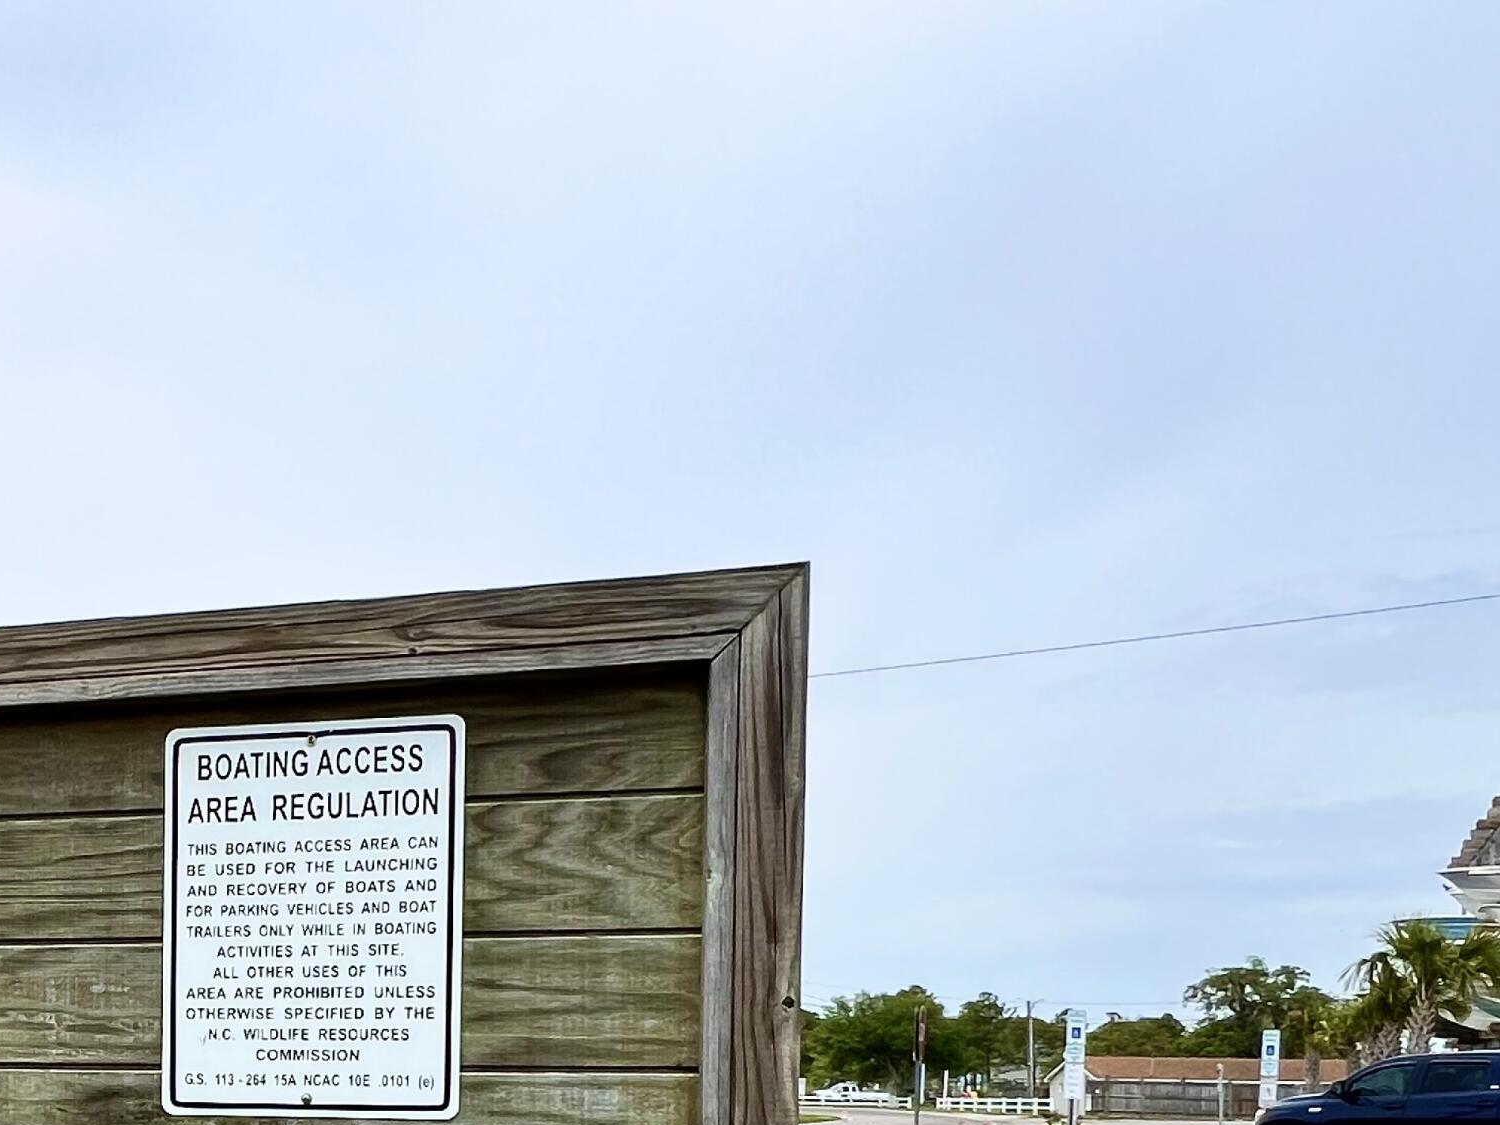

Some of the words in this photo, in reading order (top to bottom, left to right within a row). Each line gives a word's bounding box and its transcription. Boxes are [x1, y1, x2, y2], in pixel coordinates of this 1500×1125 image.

[198, 750, 308, 780] BOATING
[316, 744, 422, 776] ACCESS
[188, 796, 256, 823] AREA
[273, 788, 438, 821] REGULATION
[188, 844, 217, 855] THIS
[226, 841, 286, 855] BOATING
[295, 839, 351, 852] ACCESS
[360, 837, 399, 850] AREA
[408, 837, 438, 849] CAN
[187, 864, 205, 876] BE
[216, 863, 255, 876] USED
[265, 862, 295, 874] FOR
[306, 861, 334, 873] THE
[345, 858, 437, 872] LAUNCHING
[187, 885, 217, 896] AND
[227, 883, 306, 896] RECOVERY
[316, 882, 335, 894] OF
[346, 880, 395, 893] BOATS
[405, 879, 436, 891] AND
[187, 905, 212, 917] FOR
[221, 904, 278, 916] PARKING
[288, 902, 353, 915] VEHICLES
[361, 901, 389, 913] AND
[399, 901, 436, 913] BOAT
[187, 925, 251, 937] TRAILERS
[259, 925, 293, 936] ONLY
[302, 924, 344, 936] WHILE
[353, 924, 365, 935] IN
[375, 922, 436, 934] BOATING
[217, 945, 292, 958] ACTIVITIES
[301, 945, 317, 956] AT
[328, 944, 358, 956] THIS
[369, 944, 403, 956] SITE.
[213, 968, 238, 979] ALL
[247, 966, 293, 978] OTHER
[303, 965, 338, 977] USES
[349, 965, 365, 977] OF
[376, 965, 406, 977] THIS
[187, 987, 226, 999] AREA
[234, 987, 263, 999] ARE
[274, 987, 364, 998] PROHIBITED
[375, 986, 435, 998] UNLESS
[186, 1008, 273, 1019] OTHERWISE
[285, 1007, 364, 1019] SPECIFIED
[375, 1007, 395, 1019] BY
[404, 1007, 434, 1019] THE
[244, 1029, 308, 1041] WILDLIFE
[319, 1029, 409, 1041] RESOURCES
[256, 1049, 359, 1061] COMMISSION
[274, 1074, 296, 1086] 15A
[304, 1074, 339, 1086] NCAC
[349, 1075, 370, 1086] 10E
